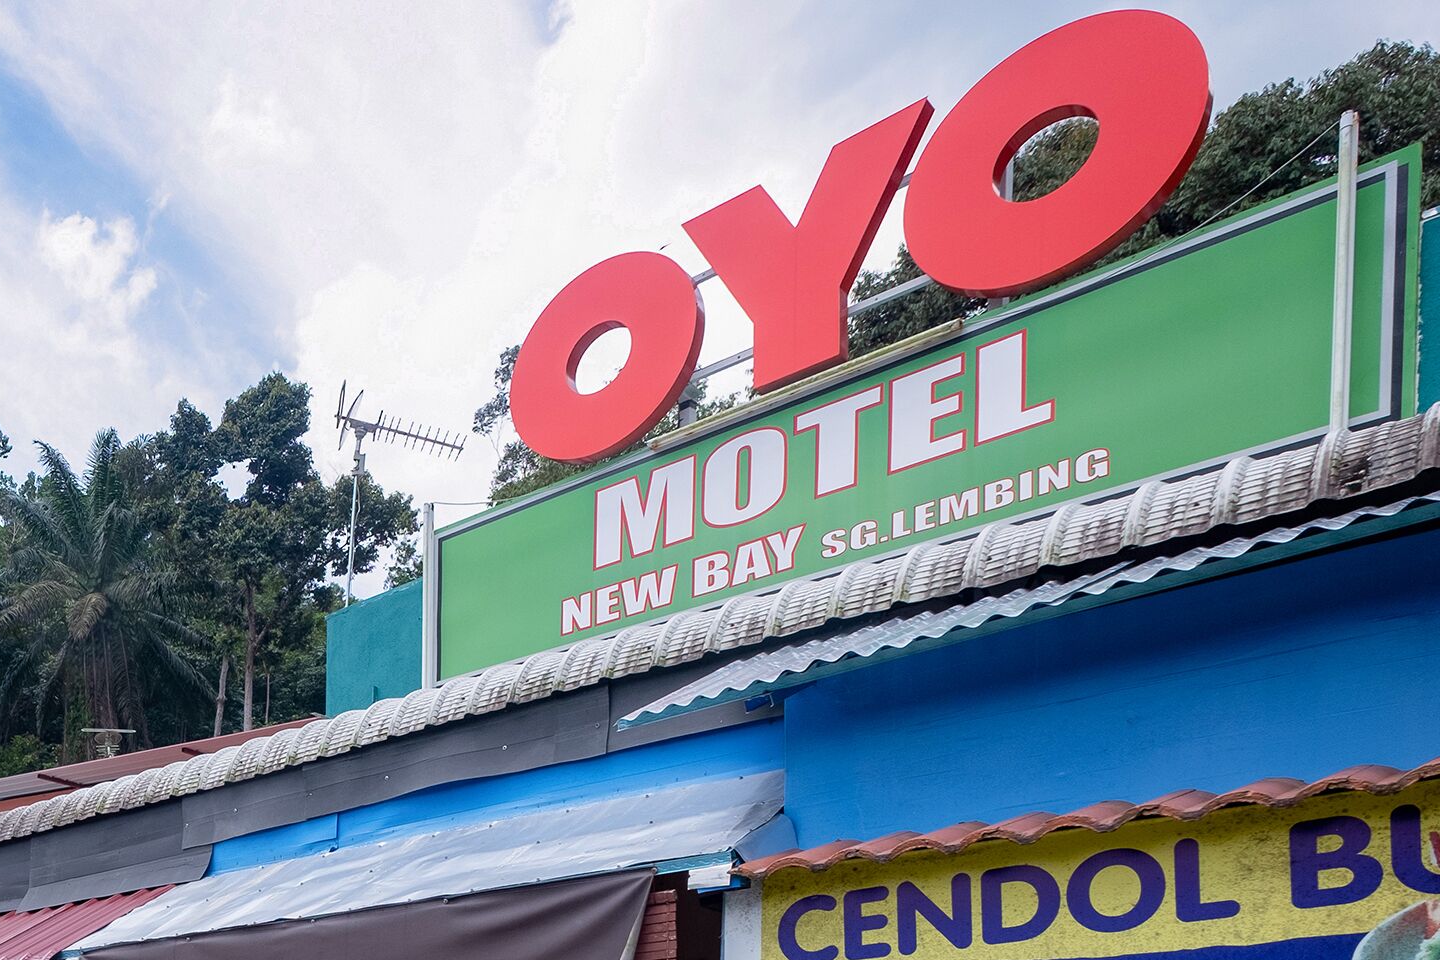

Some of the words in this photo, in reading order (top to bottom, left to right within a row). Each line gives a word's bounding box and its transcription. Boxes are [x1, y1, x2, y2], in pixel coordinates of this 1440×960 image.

[510, 9, 1212, 465] OYO
[560, 565, 679, 637] NEW
[691, 523, 806, 598] BAY
[821, 449, 1111, 559] SG.LEMBING
[593, 330, 1056, 570] MOTEL
